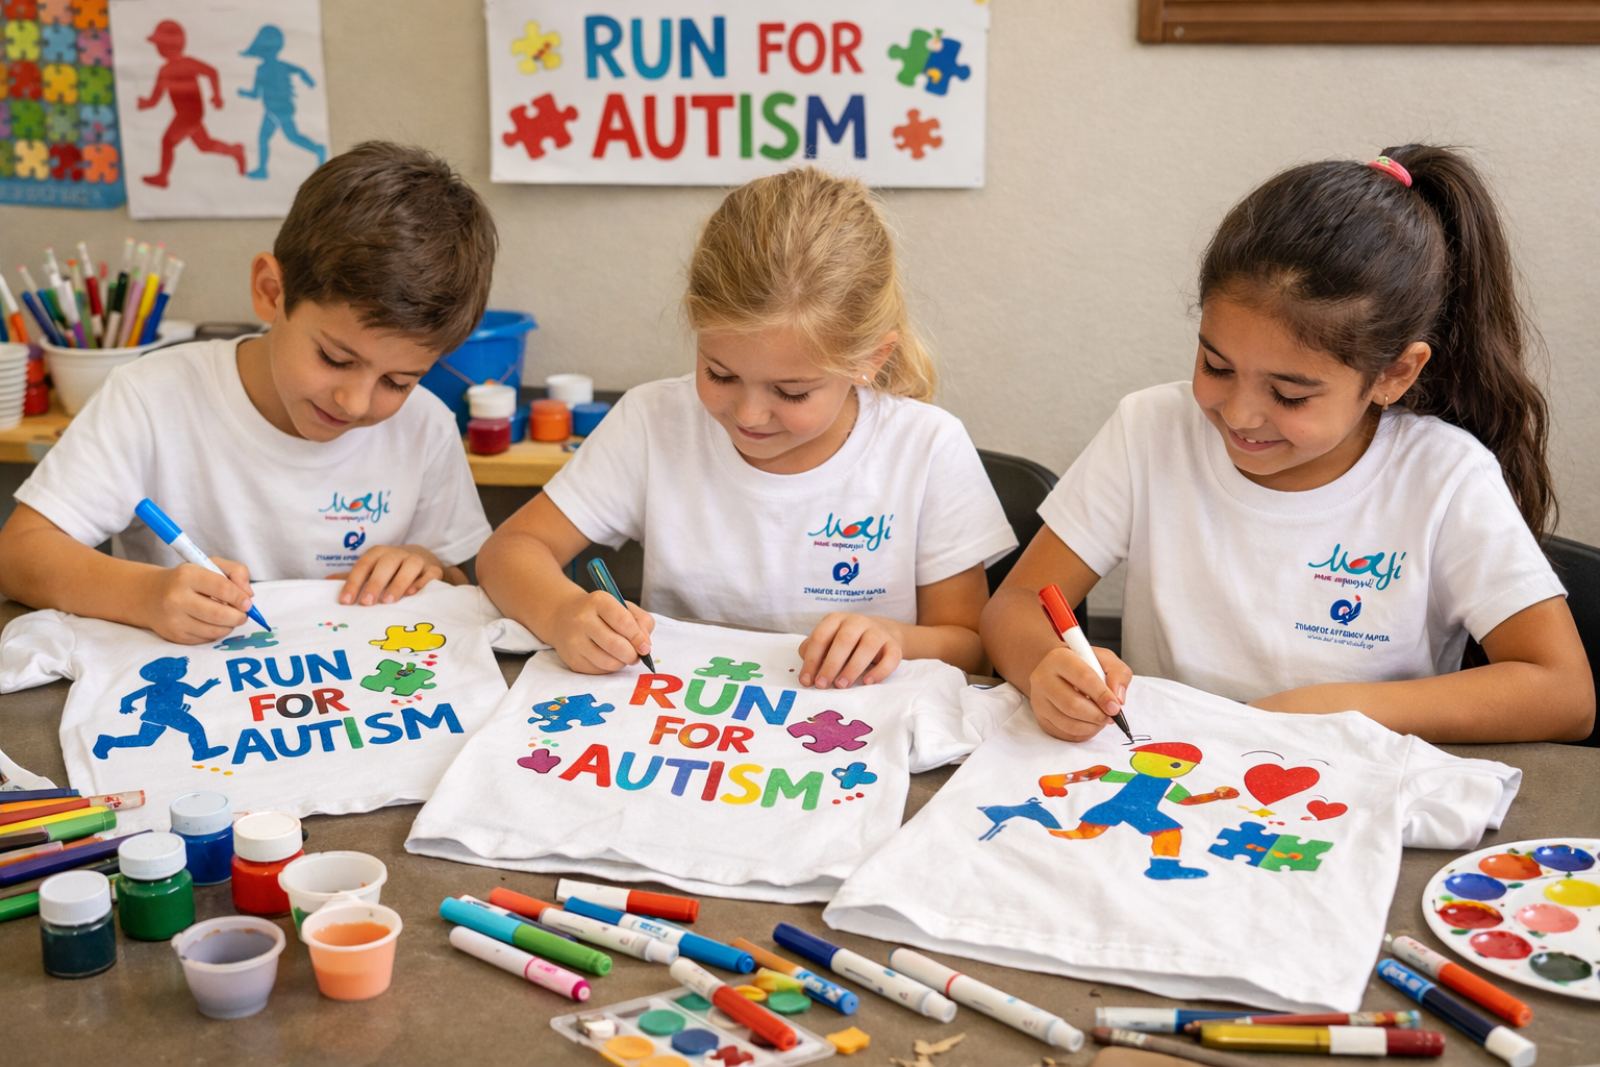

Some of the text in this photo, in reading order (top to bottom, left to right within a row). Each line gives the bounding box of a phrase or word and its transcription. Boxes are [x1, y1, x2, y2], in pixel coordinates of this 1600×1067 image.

[584, 15, 864, 79] RUN FOR
[591, 92, 867, 160] AUTISM
[226, 649, 352, 692] RUN
[629, 673, 797, 725] RUN
[248, 687, 351, 722] FOR
[231, 702, 464, 765] AUTISM
[649, 715, 754, 753] FOR
[558, 743, 824, 811] AUTISM
